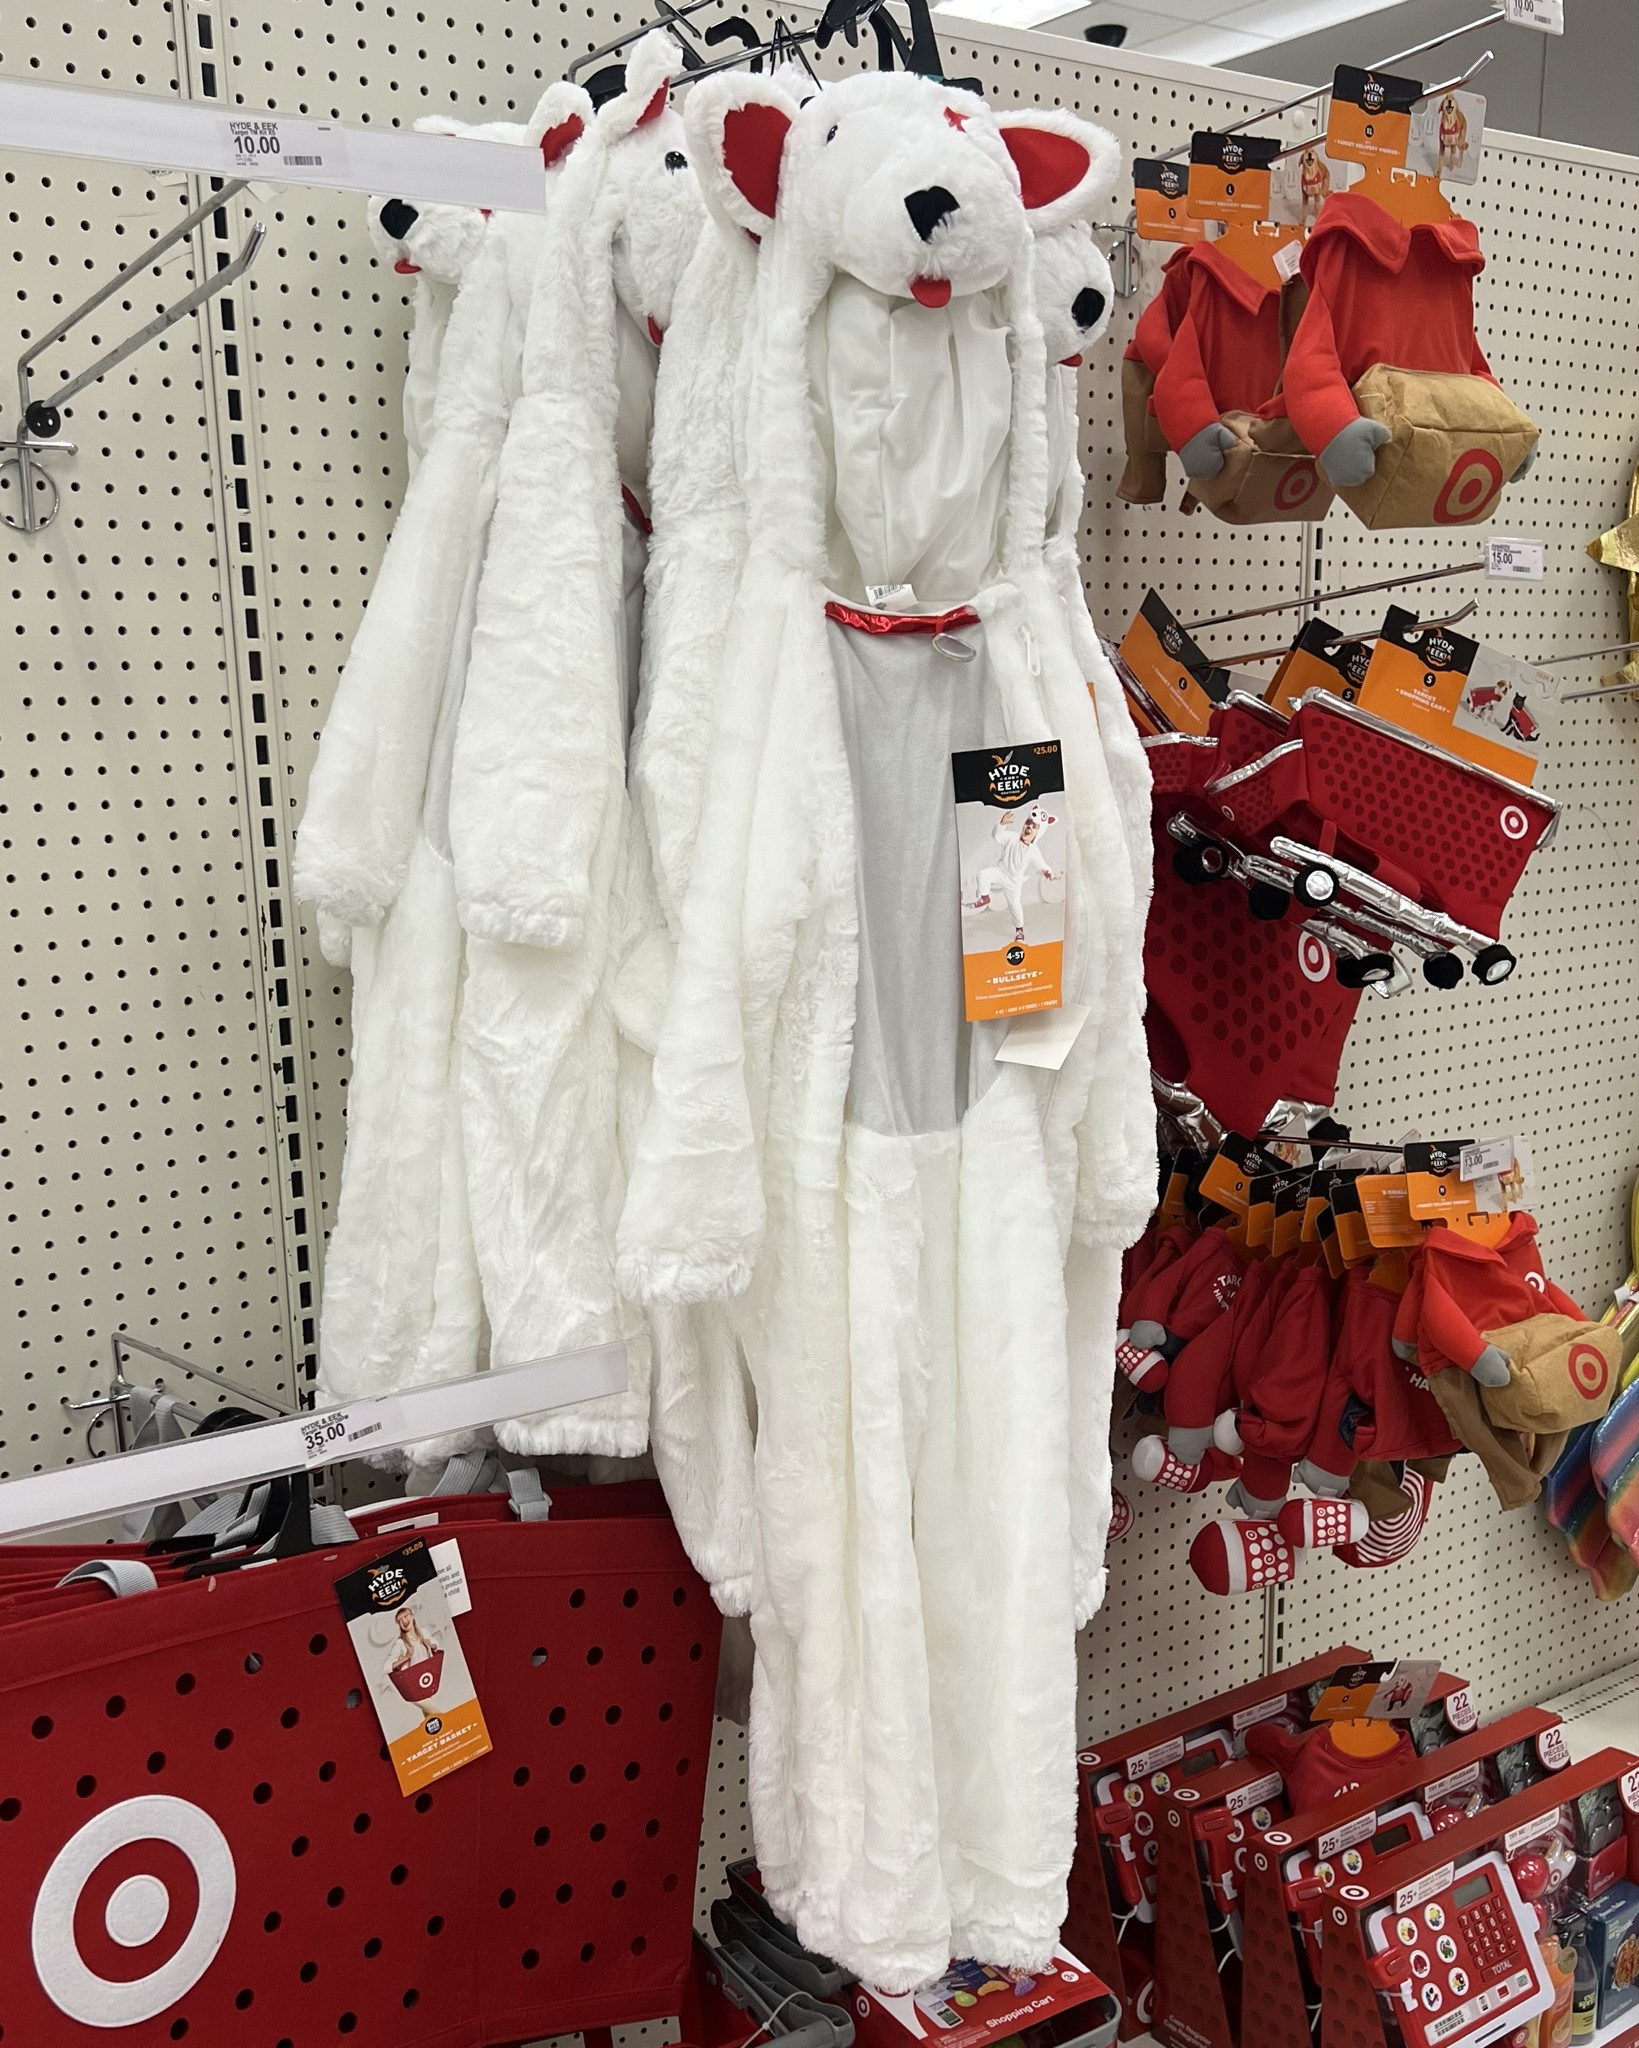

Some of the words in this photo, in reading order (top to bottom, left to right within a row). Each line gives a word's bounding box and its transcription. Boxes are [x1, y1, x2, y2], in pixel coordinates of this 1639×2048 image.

[1364, 83, 1385, 94] HYDE
[230, 122, 252, 130] HYDE
[254, 122, 260, 130] &
[234, 136, 281, 154] 10.00
[1223, 145, 1243, 154] HYDE
[1492, 552, 1513, 564] 15.00
[1166, 624, 1183, 646] HYDE
[1429, 637, 1455, 653] HYDE
[1430, 648, 1448, 658] EEK!
[1426, 675, 1433, 684] S
[1345, 691, 1352, 700] S
[1413, 688, 1437, 700] TARGET
[1033, 745, 1058, 755] $25.00
[987, 764, 1030, 781] HYDE
[997, 779, 1024, 791] EEK!
[1006, 951, 1025, 960] 4-5T
[992, 971, 1038, 984] BULLSEYE
[1246, 1152, 1263, 1165] HYDE
[1429, 1151, 1447, 1159] HYDE
[1465, 1154, 1483, 1167] 13.00
[301, 1420, 320, 1434] HYDE
[328, 1411, 343, 1422] EEK
[305, 1422, 345, 1449] 35.00
[402, 1541, 424, 1556] $35.00
[368, 1568, 403, 1592] HYDE
[445, 1578, 463, 1591] product
[378, 1581, 402, 1599] EEK!
[448, 1587, 461, 1597] child
[1453, 1692, 1470, 1712] 22
[1452, 1708, 1472, 1721] PIECES
[1457, 1712, 1478, 1727] PIEZAS
[406, 1742, 439, 1762] TARGET
[440, 1724, 472, 1745] BASKET
[1545, 1729, 1562, 1749] 22
[1543, 1743, 1564, 1758] PIECES
[1548, 1750, 1569, 1765] PIEZAS
[1130, 1759, 1149, 1776] 25+
[1230, 1795, 1248, 1811] 25+
[1322, 1837, 1340, 1854] 25+
[1400, 1890, 1418, 1908] 25+
[1462, 1915, 1469, 1926] 7
[1474, 1910, 1481, 1920] 8
[1484, 1904, 1492, 1914] 9
[1467, 1928, 1474, 1938] 4
[1478, 1923, 1486, 1933] 5
[1489, 1917, 1496, 1927] 6
[1472, 1942, 1479, 1952] 1
[1483, 1936, 1491, 1946] 2
[1494, 1930, 1501, 1940] 3
[1491, 1960, 1513, 1975] TOTAL
[986, 2004, 1034, 2028] Shopping
[1031, 1995, 1055, 2009] Cart
